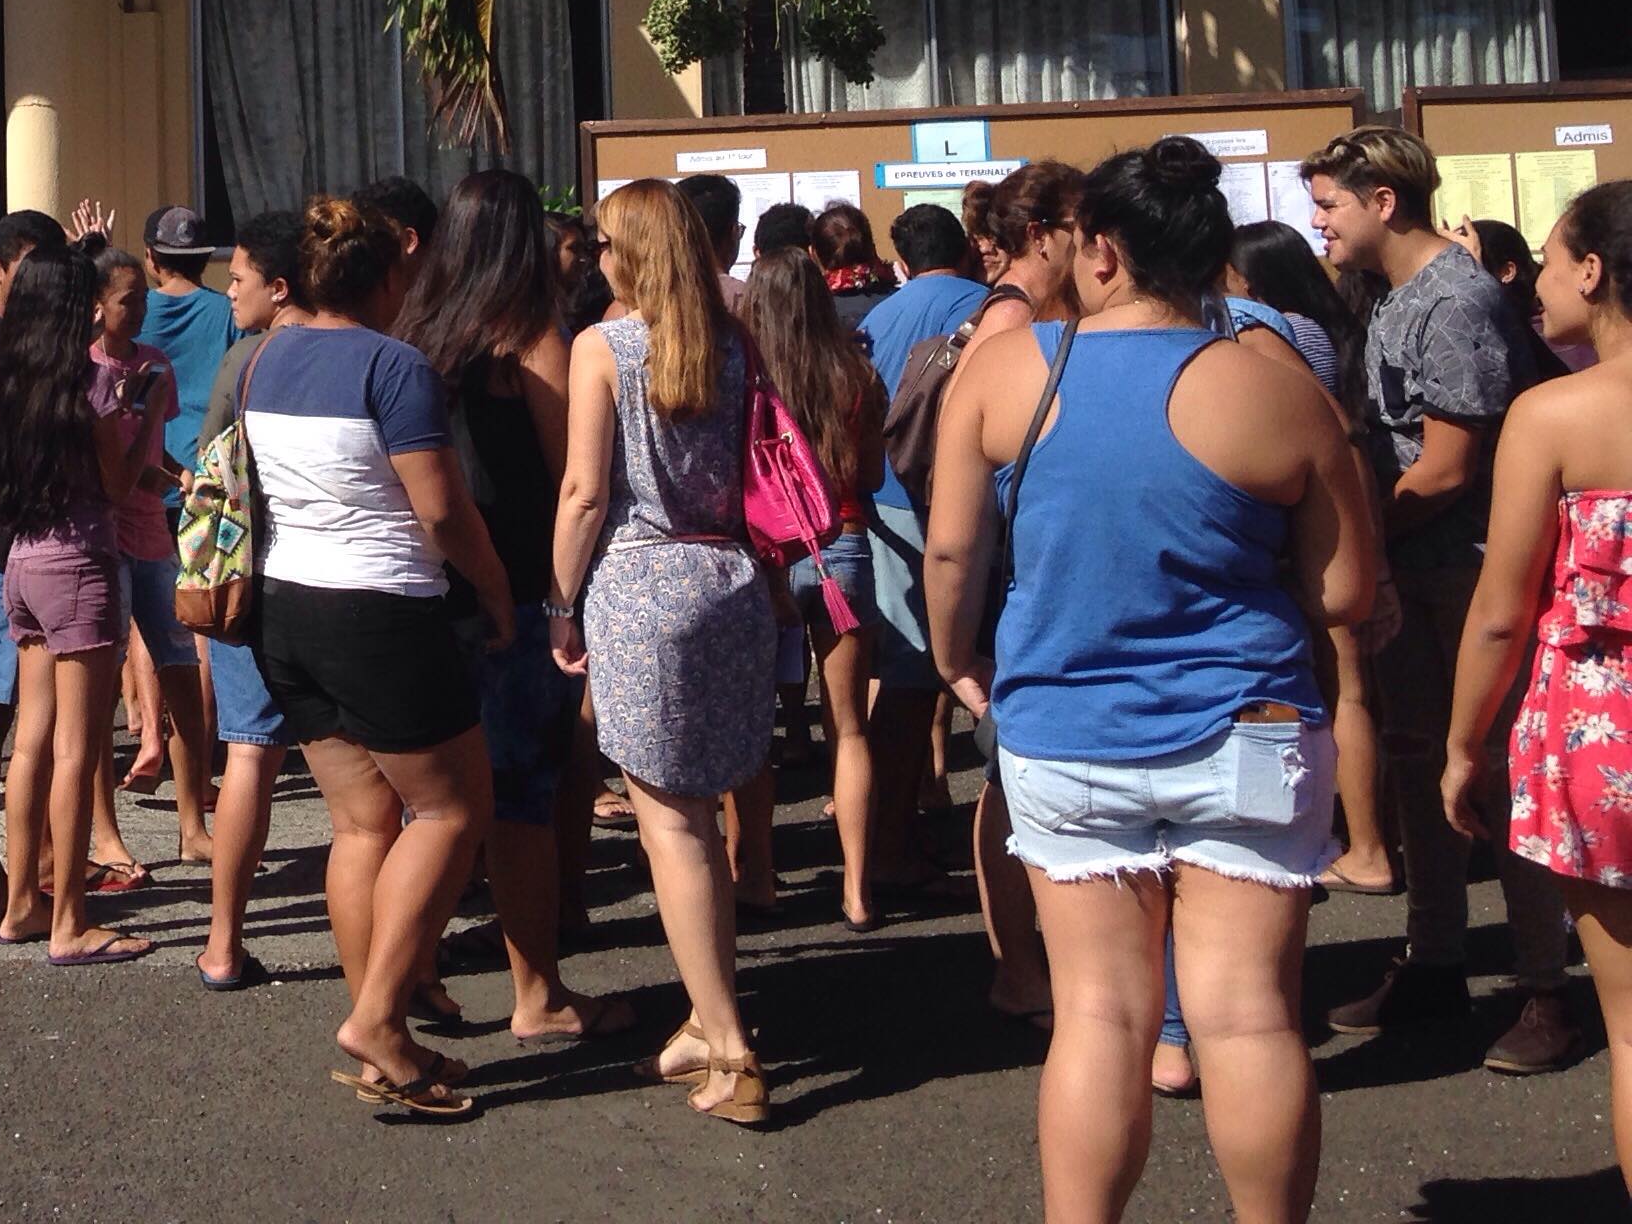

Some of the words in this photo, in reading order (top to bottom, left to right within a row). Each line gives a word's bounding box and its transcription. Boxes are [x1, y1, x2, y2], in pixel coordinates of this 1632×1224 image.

[1563, 131, 1608, 143] Admis
[945, 140, 957, 156] L
[895, 170, 943, 179] EPREUVES
[945, 170, 957, 178] de
[959, 168, 1012, 176] TERMINALE
